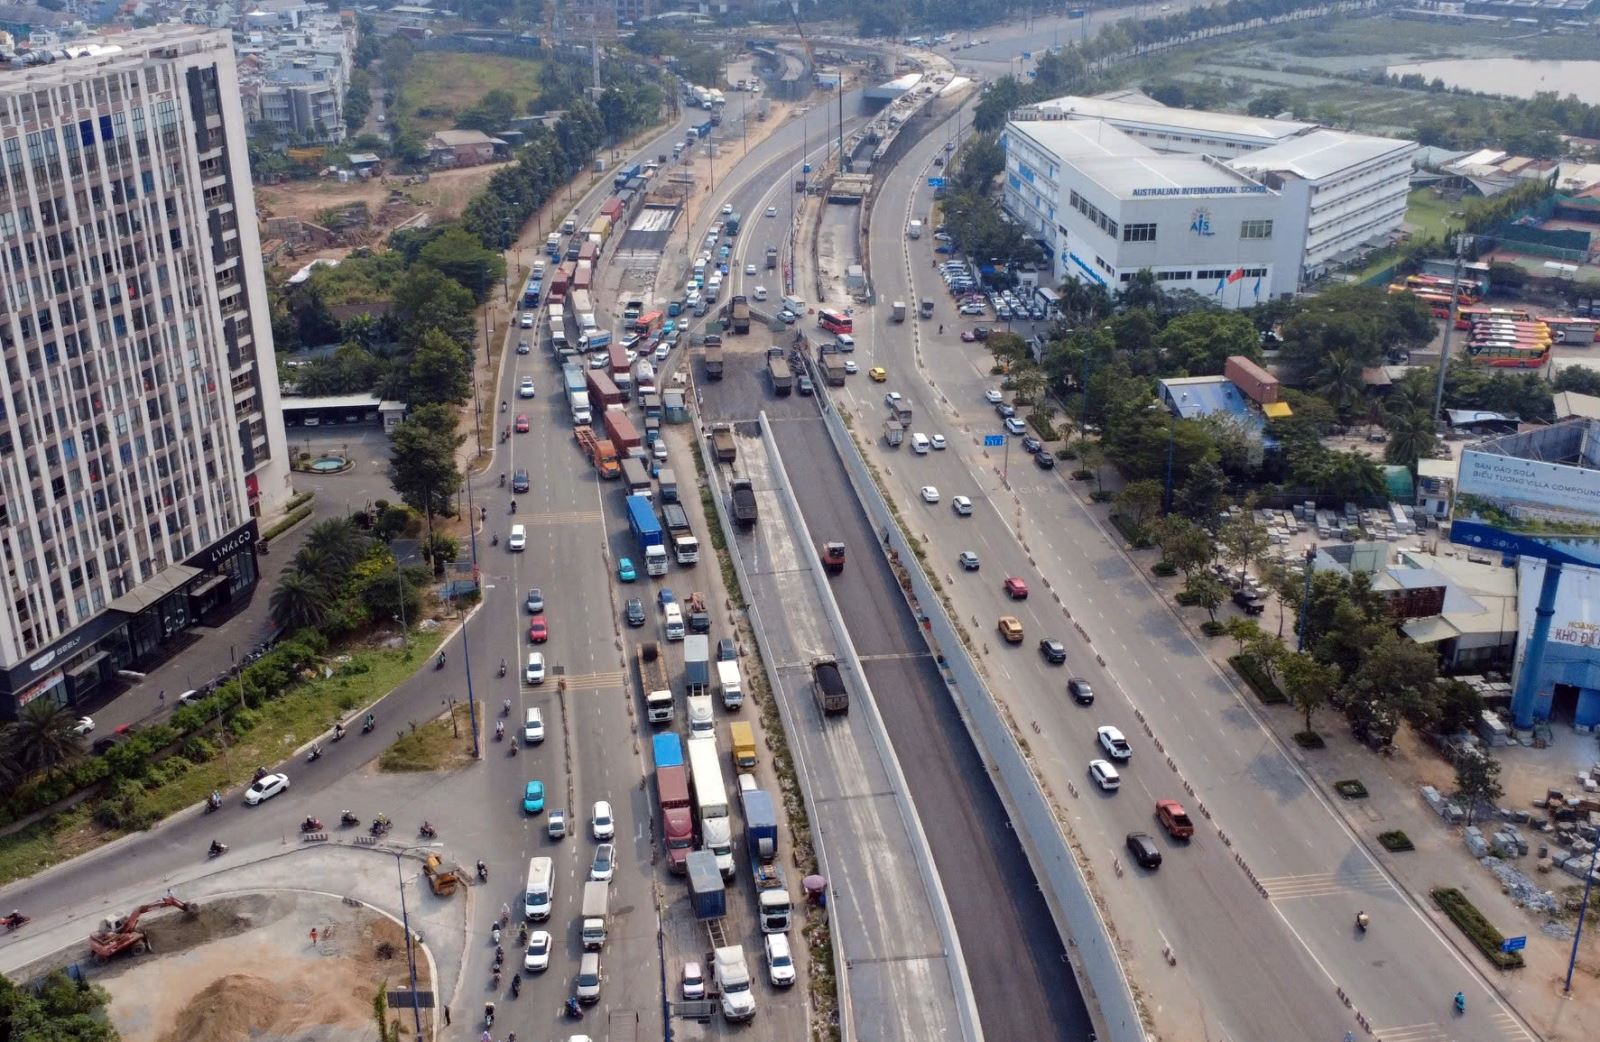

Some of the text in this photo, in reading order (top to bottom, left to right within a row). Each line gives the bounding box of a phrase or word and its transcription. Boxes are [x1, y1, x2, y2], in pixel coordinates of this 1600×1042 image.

[1132, 185, 1267, 196] AUSTRALIAN INTERNATIONAL SCHOOL
[1555, 628, 1578, 642] KHO
